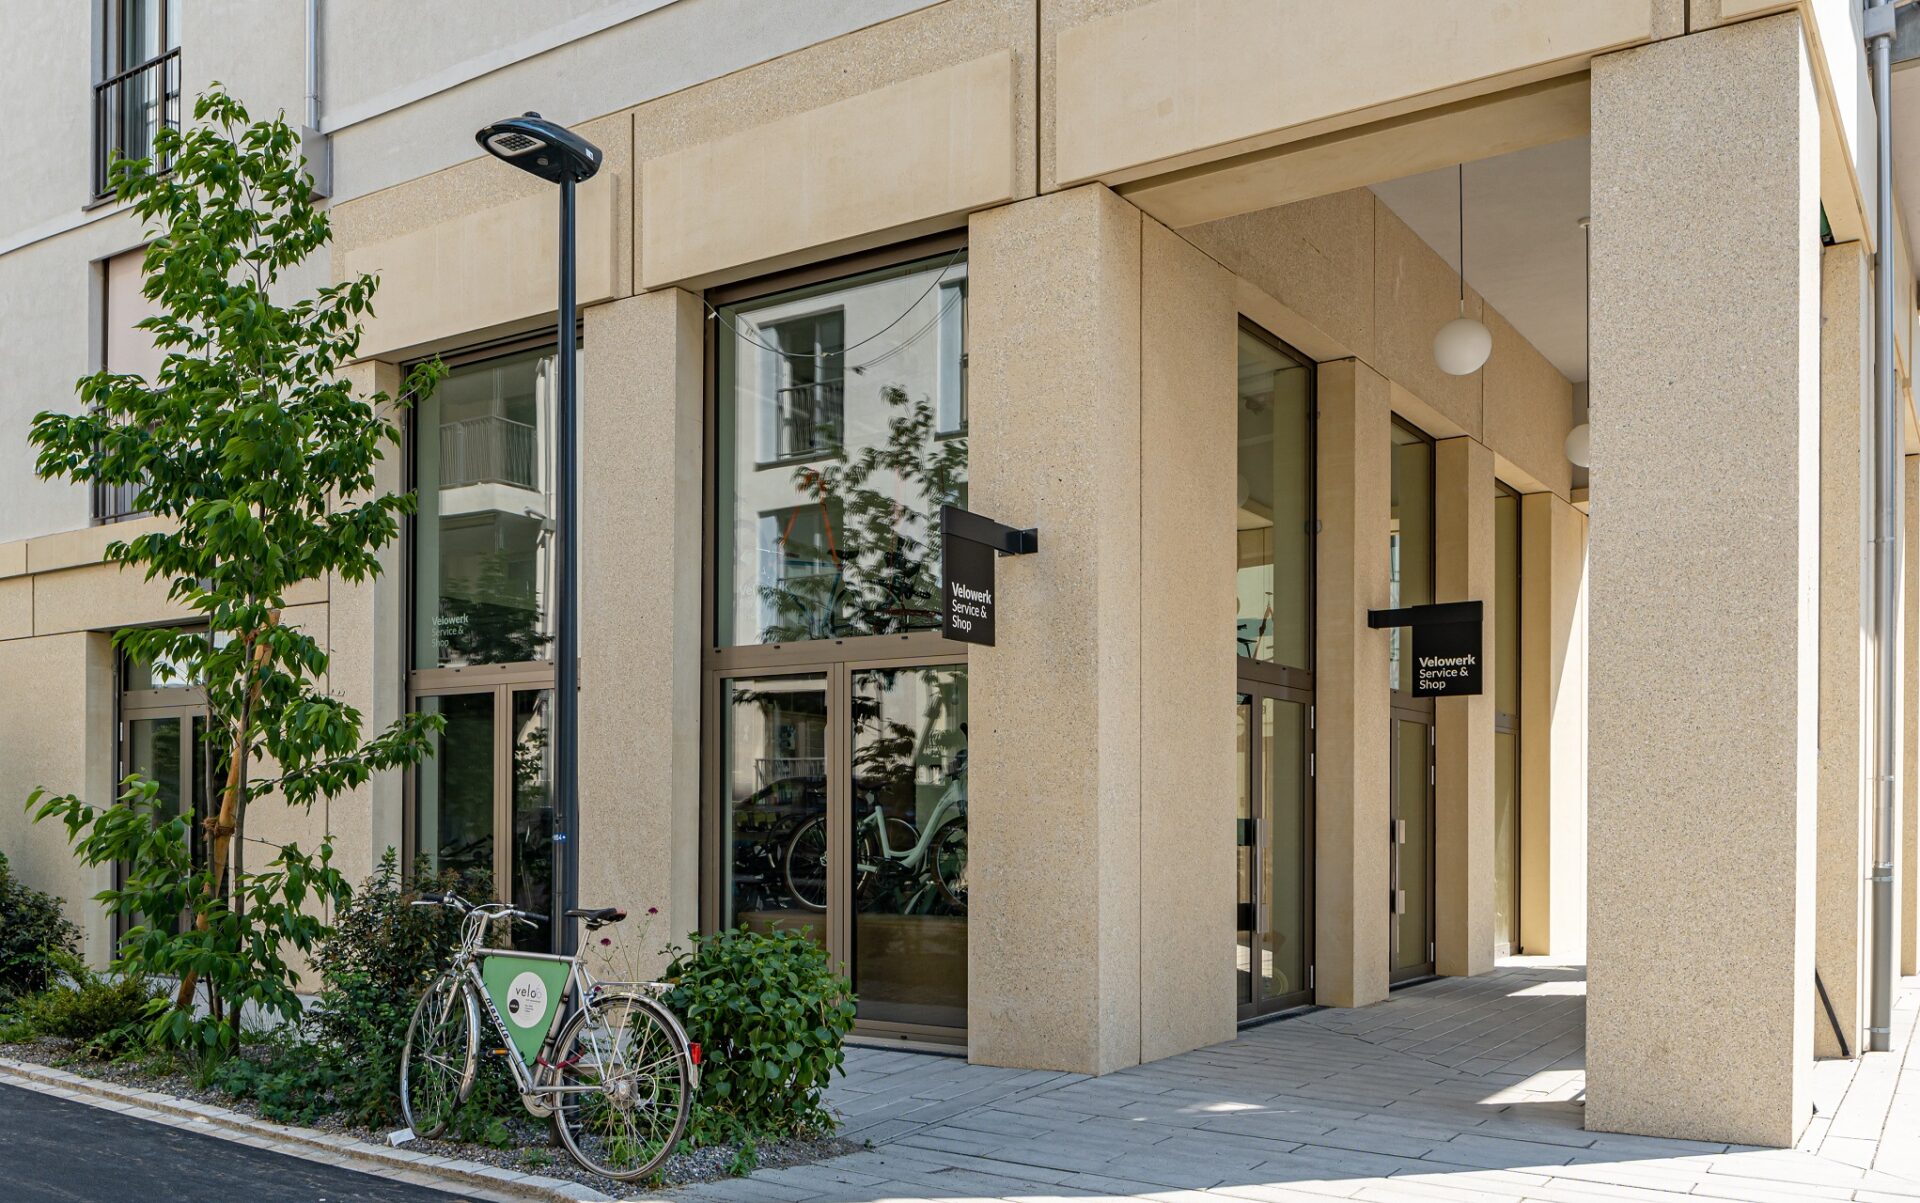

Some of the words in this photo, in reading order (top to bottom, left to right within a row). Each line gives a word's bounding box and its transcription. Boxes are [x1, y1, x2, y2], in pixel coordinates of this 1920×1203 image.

[951, 581, 992, 605] Velowerk
[952, 599, 980, 617] Service
[980, 605, 988, 619] &
[431, 613, 469, 626] Velowerk
[952, 614, 972, 633] Shop
[431, 638, 450, 649] Shop
[1418, 653, 1476, 668] Velowerk
[1419, 667, 1458, 679] Service
[1459, 666, 1469, 677] &
[1419, 679, 1446, 691] Shop
